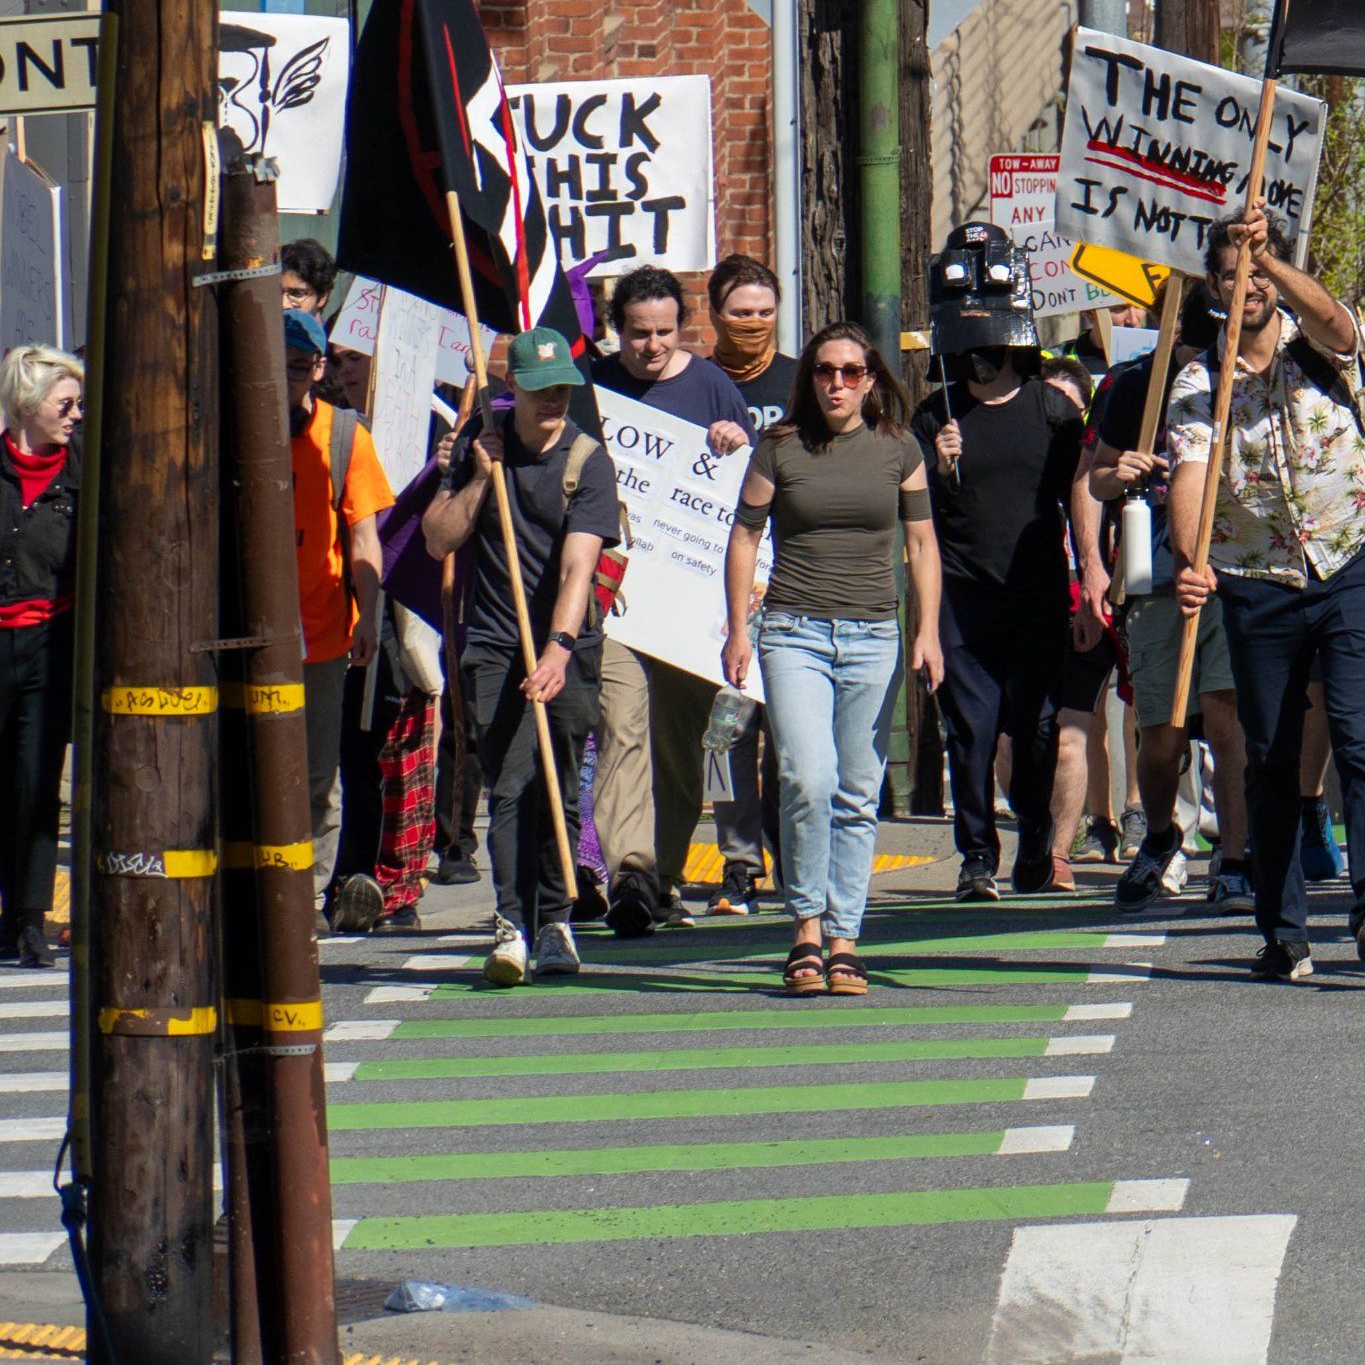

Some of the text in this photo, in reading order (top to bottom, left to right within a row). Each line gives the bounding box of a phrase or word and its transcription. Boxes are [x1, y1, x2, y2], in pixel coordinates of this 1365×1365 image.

[0, 37, 98, 92] NT
[1085, 45, 1203, 124] THE
[509, 91, 662, 154] UCK
[1081, 105, 1238, 183] WINNING
[528, 151, 652, 202] HIS
[991, 172, 1057, 197] NO STOPPIN
[549, 195, 687, 264] HIT
[1011, 206, 1046, 222] ANY
[1071, 177, 1128, 218] IS
[1134, 197, 1187, 242] NOT
[600, 416, 719, 481] LOW &
[616, 467, 651, 494] the
[670, 486, 713, 516] race
[653, 518, 683, 536] never
[684, 532, 711, 550] going
[713, 543, 724, 554] to
[671, 550, 685, 561] on
[686, 555, 718, 577] safety
